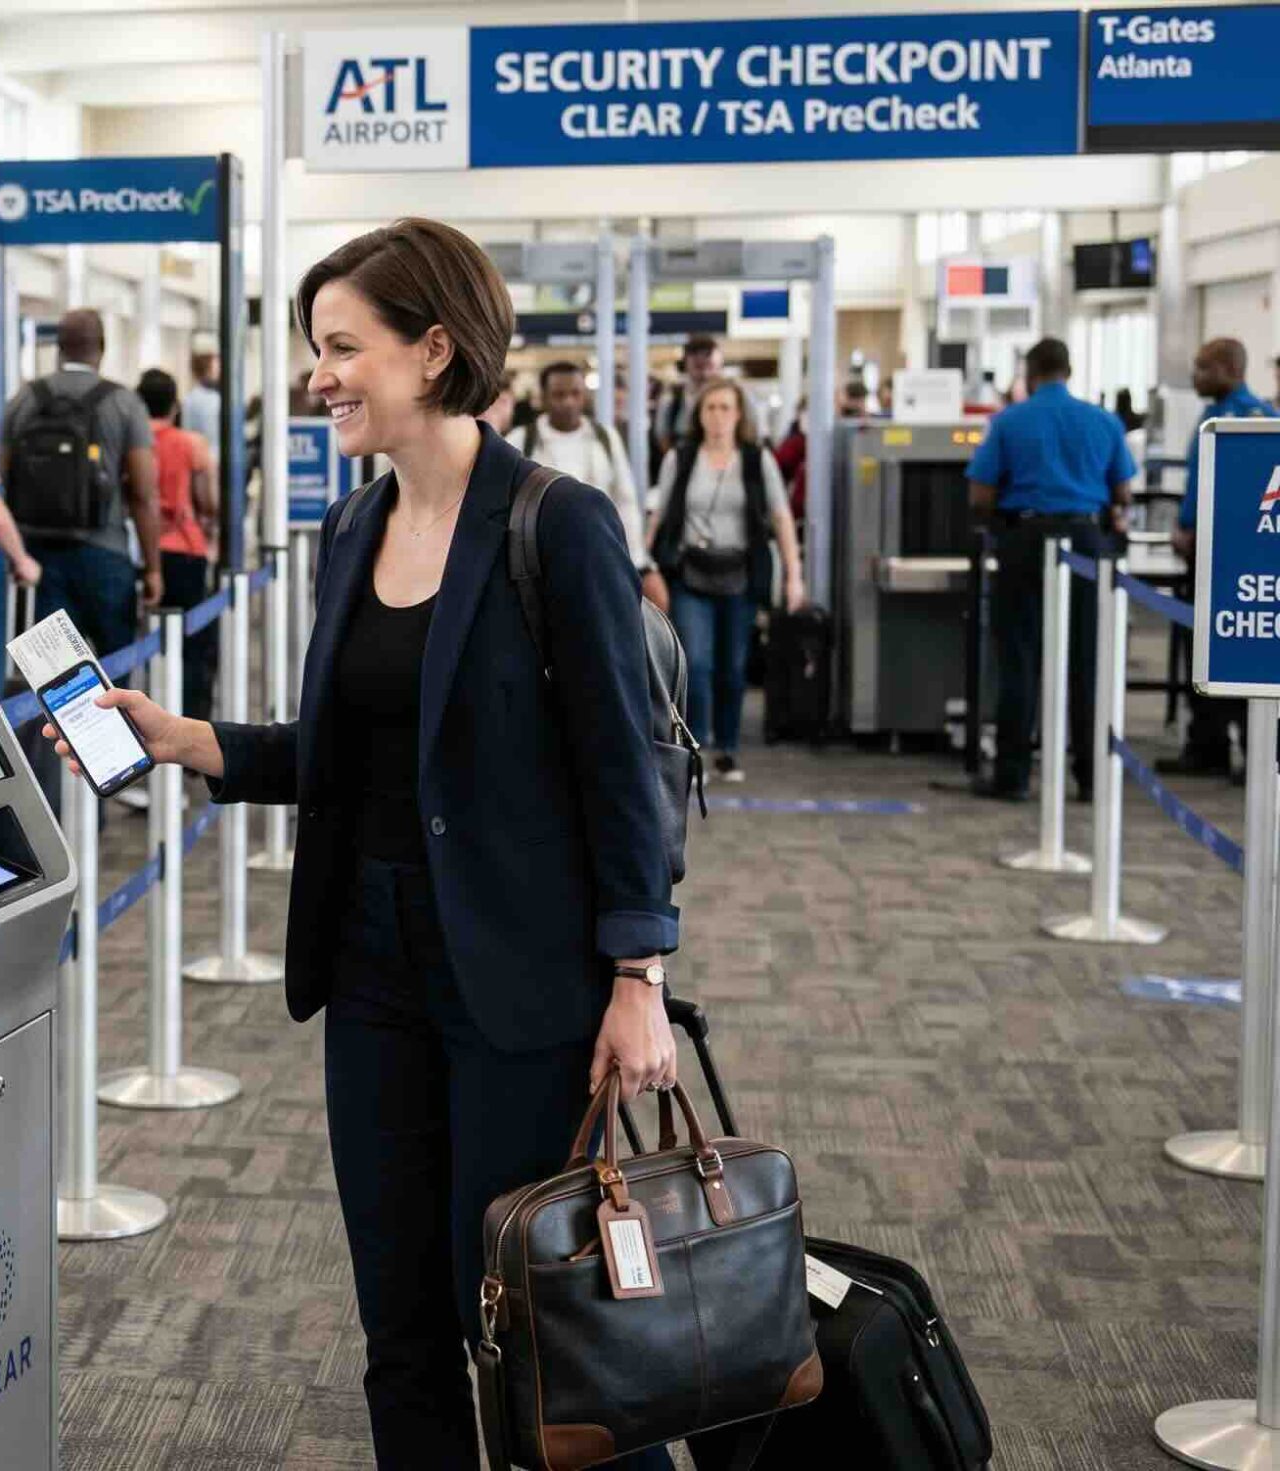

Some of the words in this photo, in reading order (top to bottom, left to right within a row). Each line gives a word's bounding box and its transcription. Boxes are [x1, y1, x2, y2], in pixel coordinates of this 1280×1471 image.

[1098, 15, 1215, 46] T-Gates
[495, 47, 724, 93] SECURITY
[736, 38, 1051, 87] CHECKPOINT
[1097, 53, 1192, 80] Atlanta
[325, 57, 449, 115] ATL
[561, 102, 682, 139] CLEAR
[691, 101, 710, 137] /
[718, 100, 795, 135] TSA
[803, 93, 980, 134] PreCheck
[324, 119, 447, 145] AIRPORT
[32, 188, 76, 214] TSA
[79, 187, 183, 213] PreCheck
